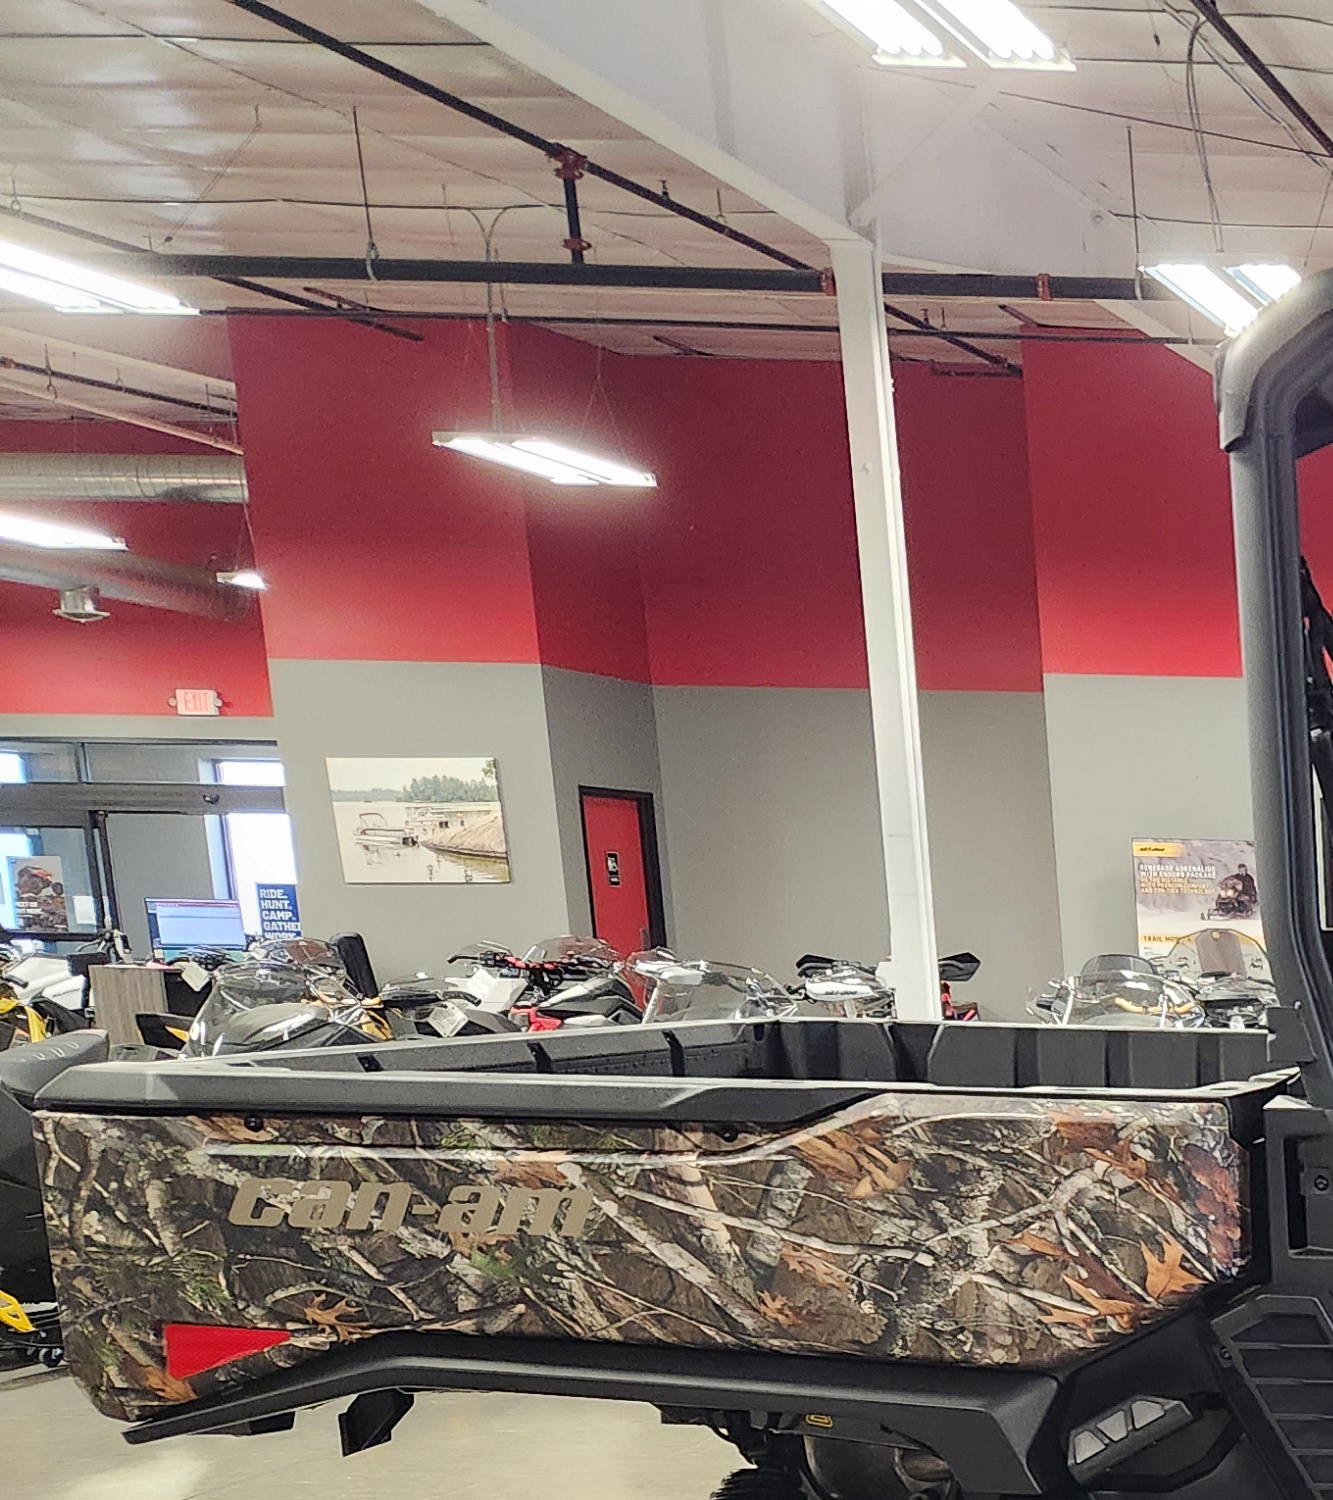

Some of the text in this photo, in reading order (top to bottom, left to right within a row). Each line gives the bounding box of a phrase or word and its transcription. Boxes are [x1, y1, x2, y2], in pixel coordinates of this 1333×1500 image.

[184, 691, 209, 711] EXIT
[259, 889, 288, 898] RIDE.
[261, 900, 293, 910] HUNT.
[262, 911, 296, 920] CAMP.
[264, 932, 297, 940] WORK
[227, 1178, 599, 1237] can-am
